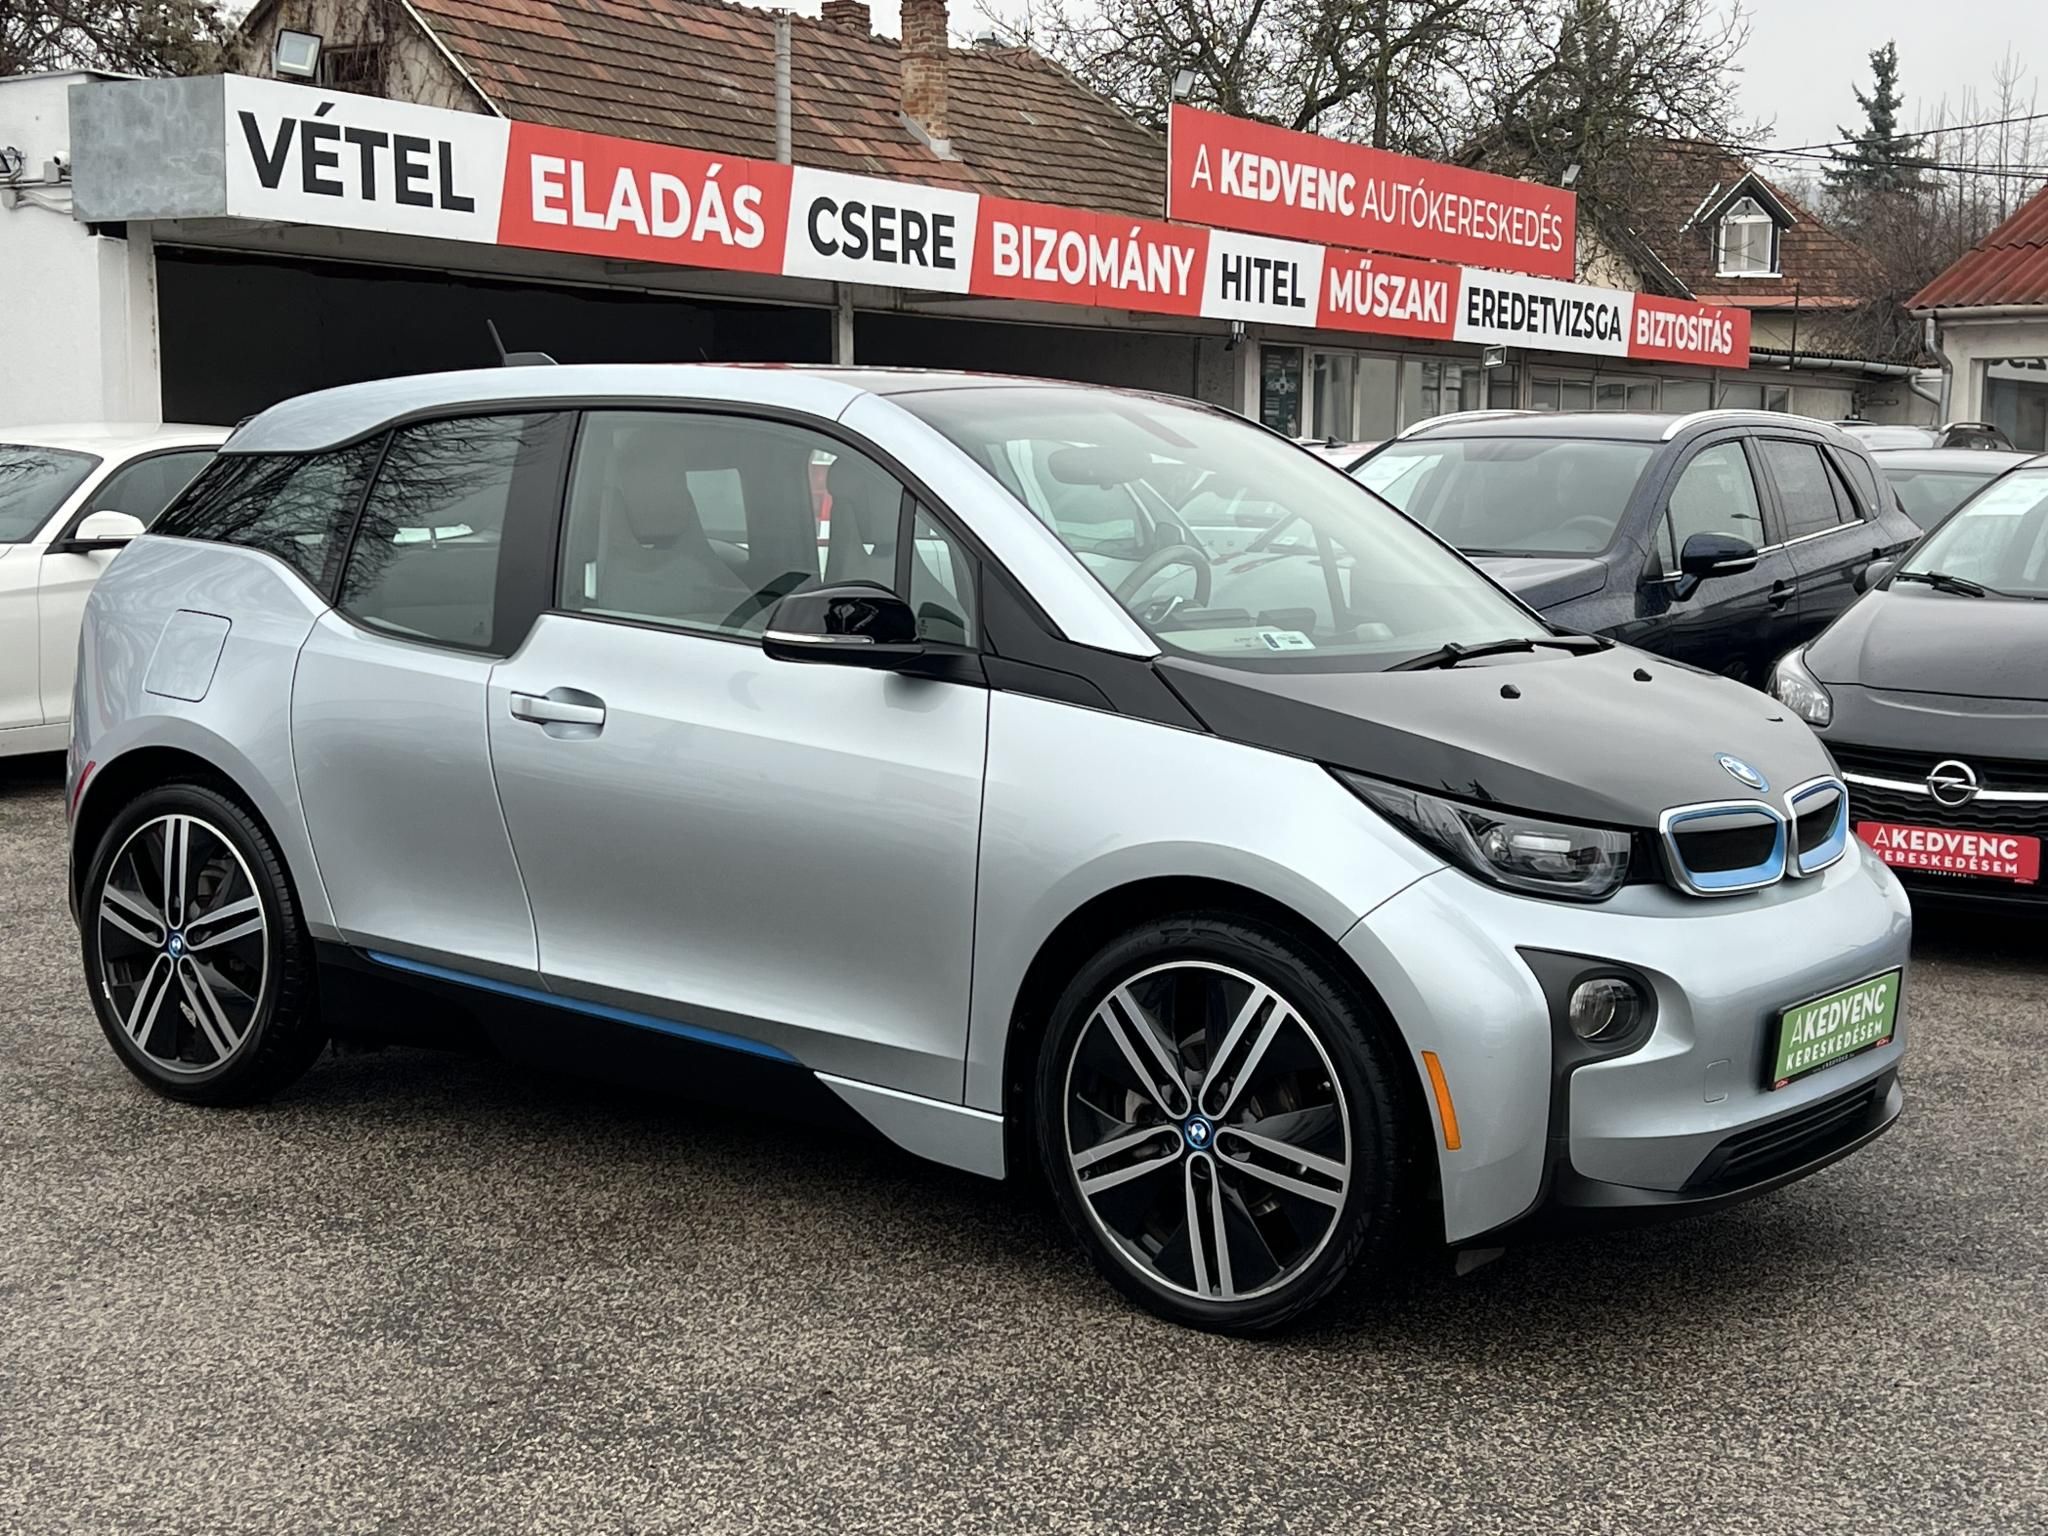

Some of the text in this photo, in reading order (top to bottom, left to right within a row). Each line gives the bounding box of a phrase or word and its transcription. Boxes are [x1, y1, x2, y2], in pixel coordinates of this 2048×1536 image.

[238, 101, 1732, 355] VÉTEL ELADÁS CSERE BIZOMÁNY HITEL MŰSZAKI EREDETVIZSGA BIZTOSÍTÁS
[1190, 143, 1563, 252] A KEDVENC AUTÓKERESKEDÉS
[1785, 1020, 1883, 1071] KERESKEDÉSEM
